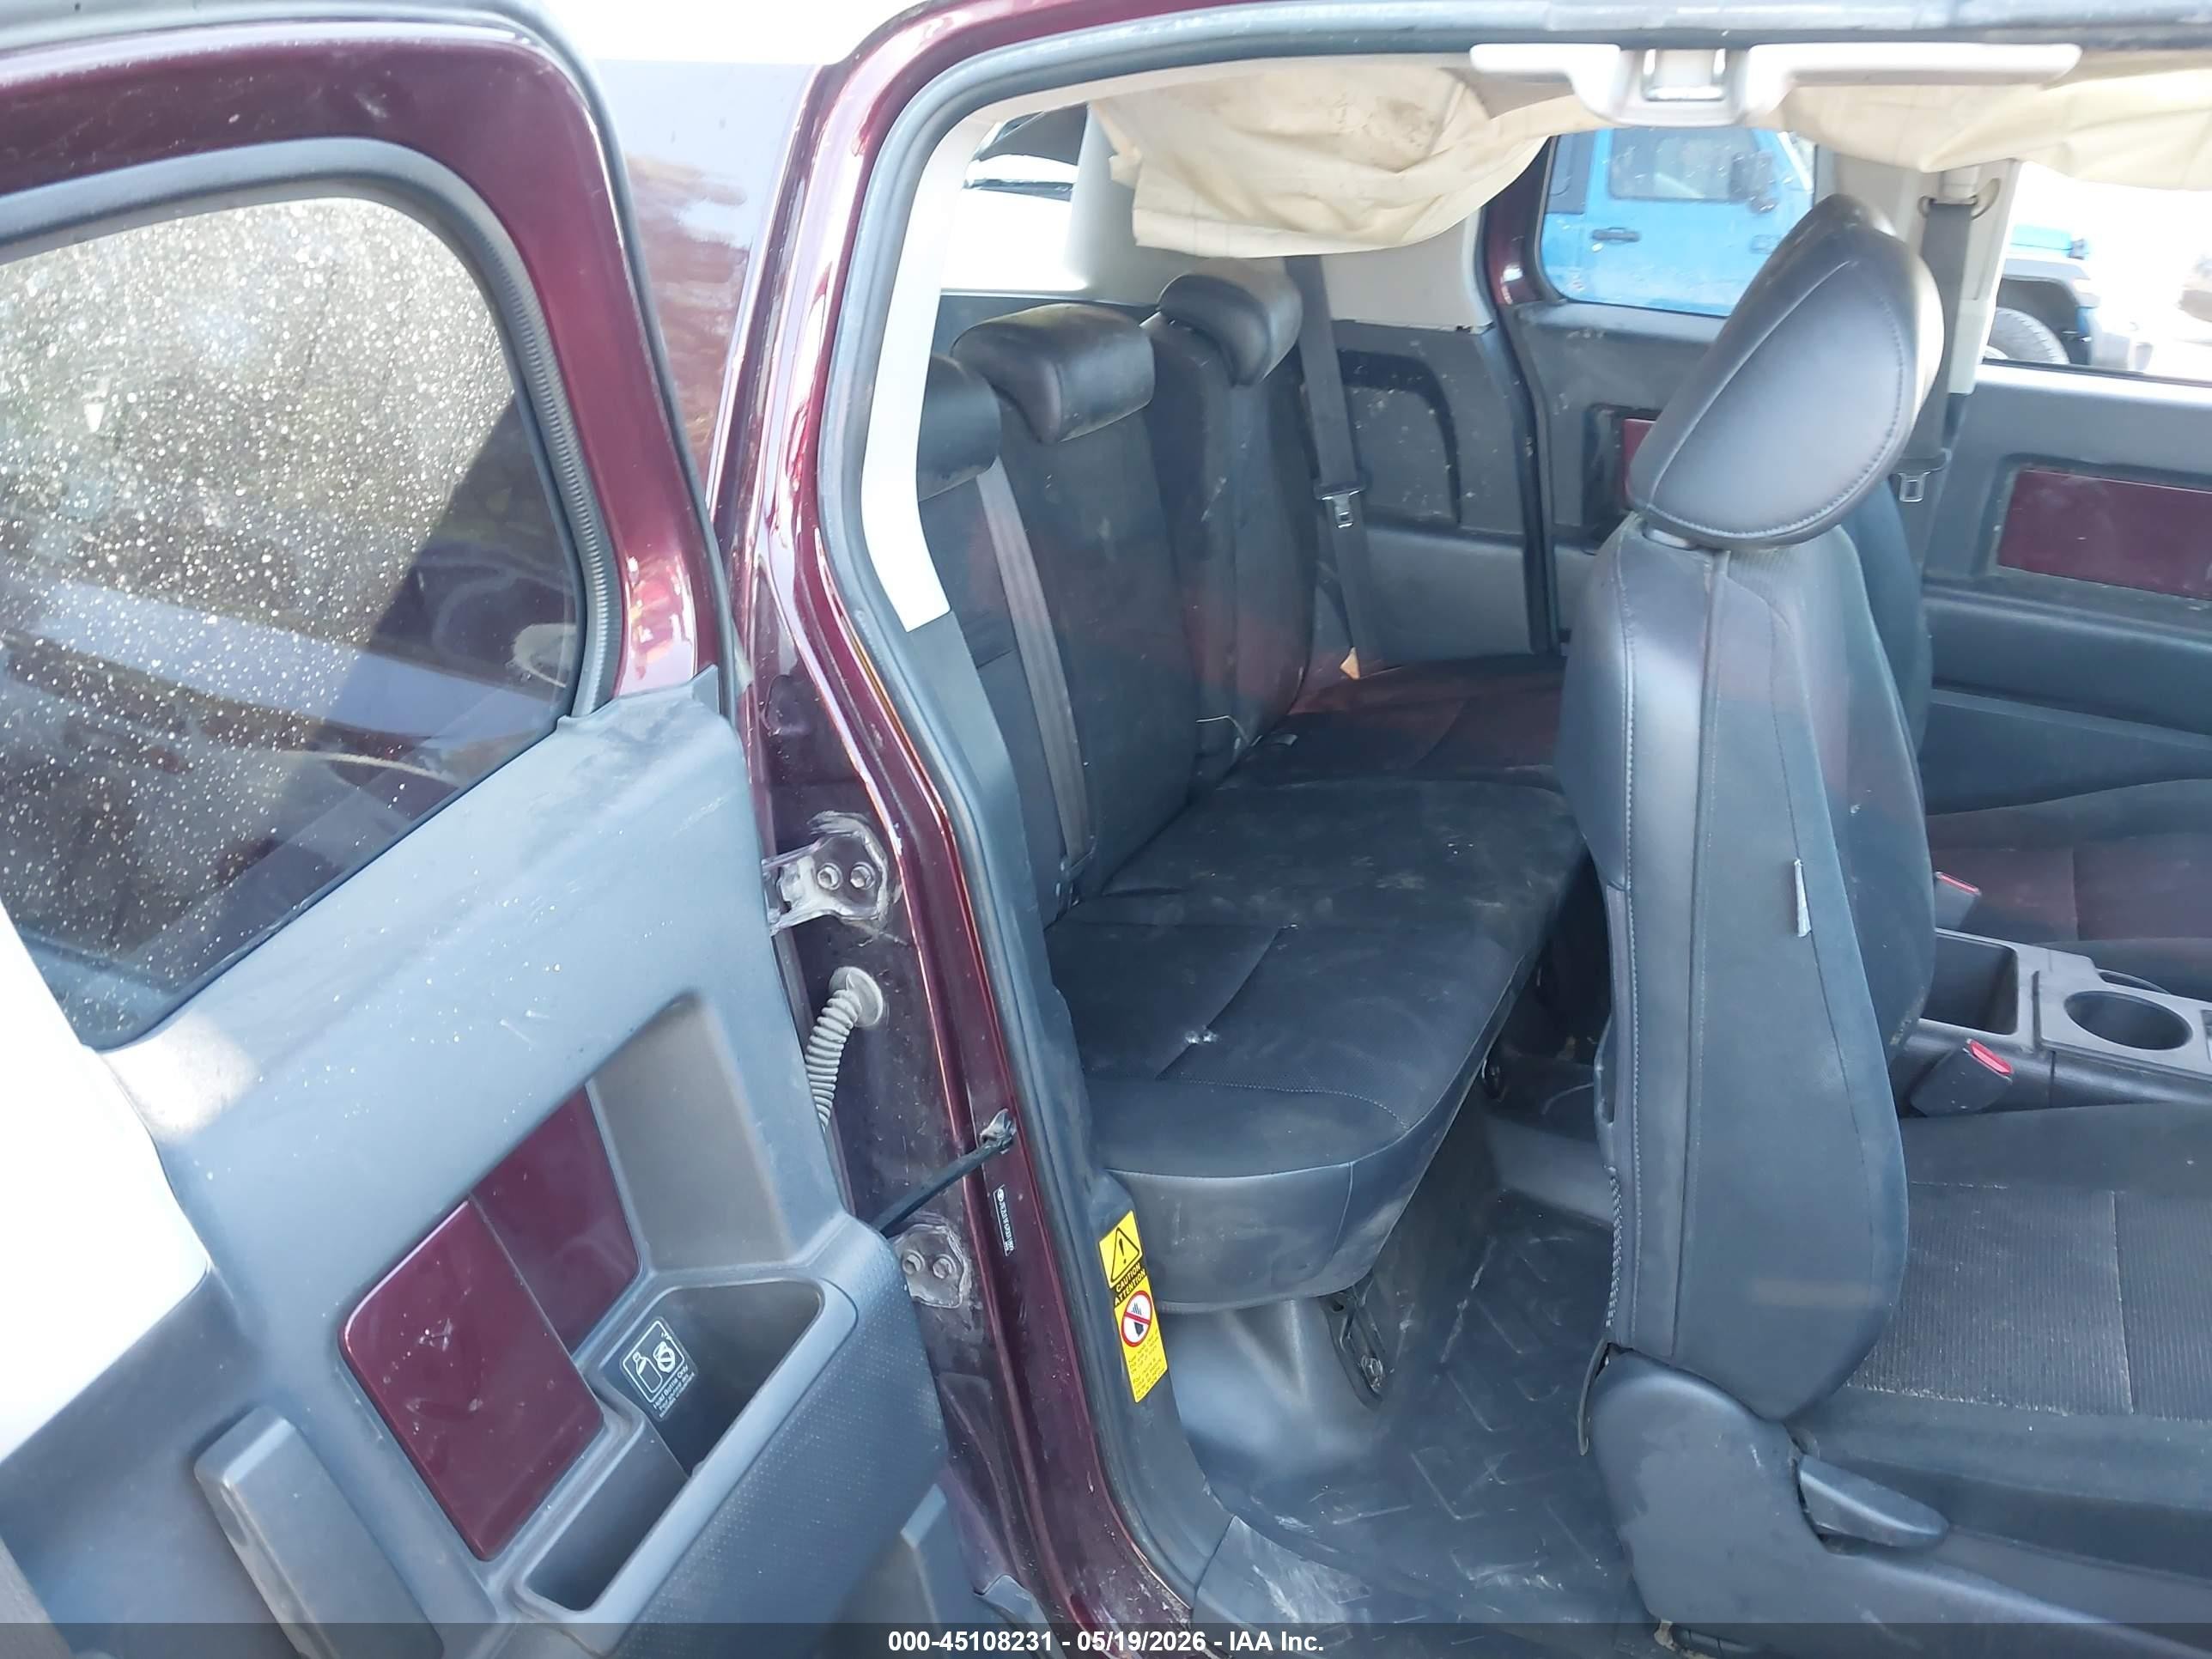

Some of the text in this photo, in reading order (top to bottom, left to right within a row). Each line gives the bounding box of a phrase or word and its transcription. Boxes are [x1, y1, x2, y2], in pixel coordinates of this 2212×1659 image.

[1115, 1268, 1146, 1306] ATTENTION
[1116, 1262, 1140, 1292] CAUTION
[653, 1364, 688, 1409] Hold Bottle Only
